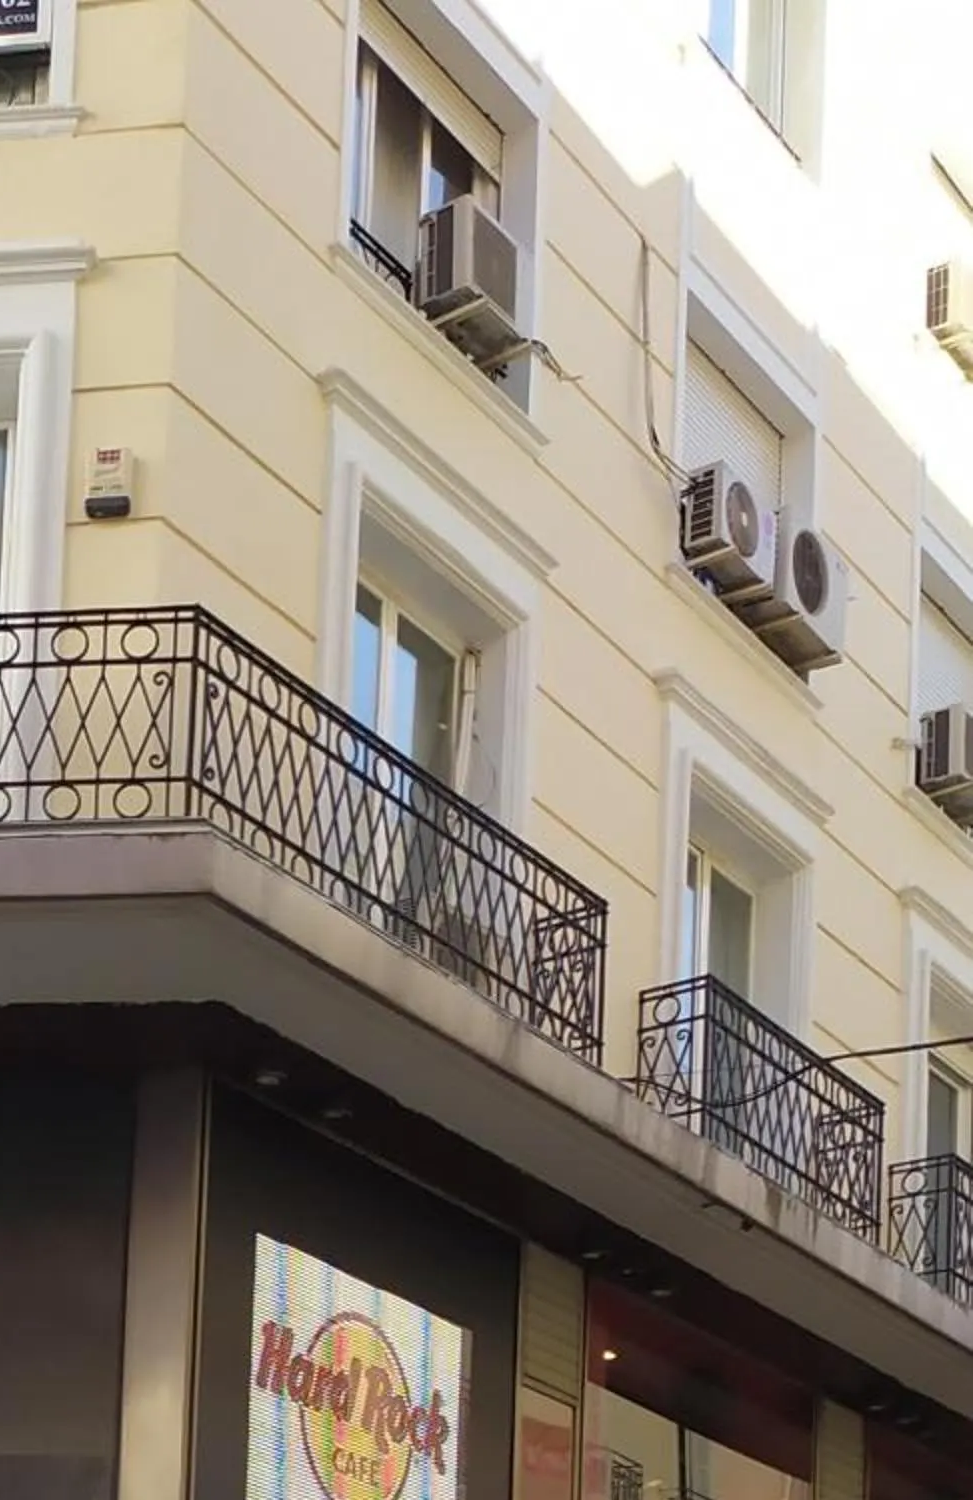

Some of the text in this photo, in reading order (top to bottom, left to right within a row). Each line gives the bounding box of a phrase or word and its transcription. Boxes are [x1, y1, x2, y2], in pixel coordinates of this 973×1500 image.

[256, 1320, 448, 1476] Hard Rock
[332, 1447, 379, 1487] CAFE
